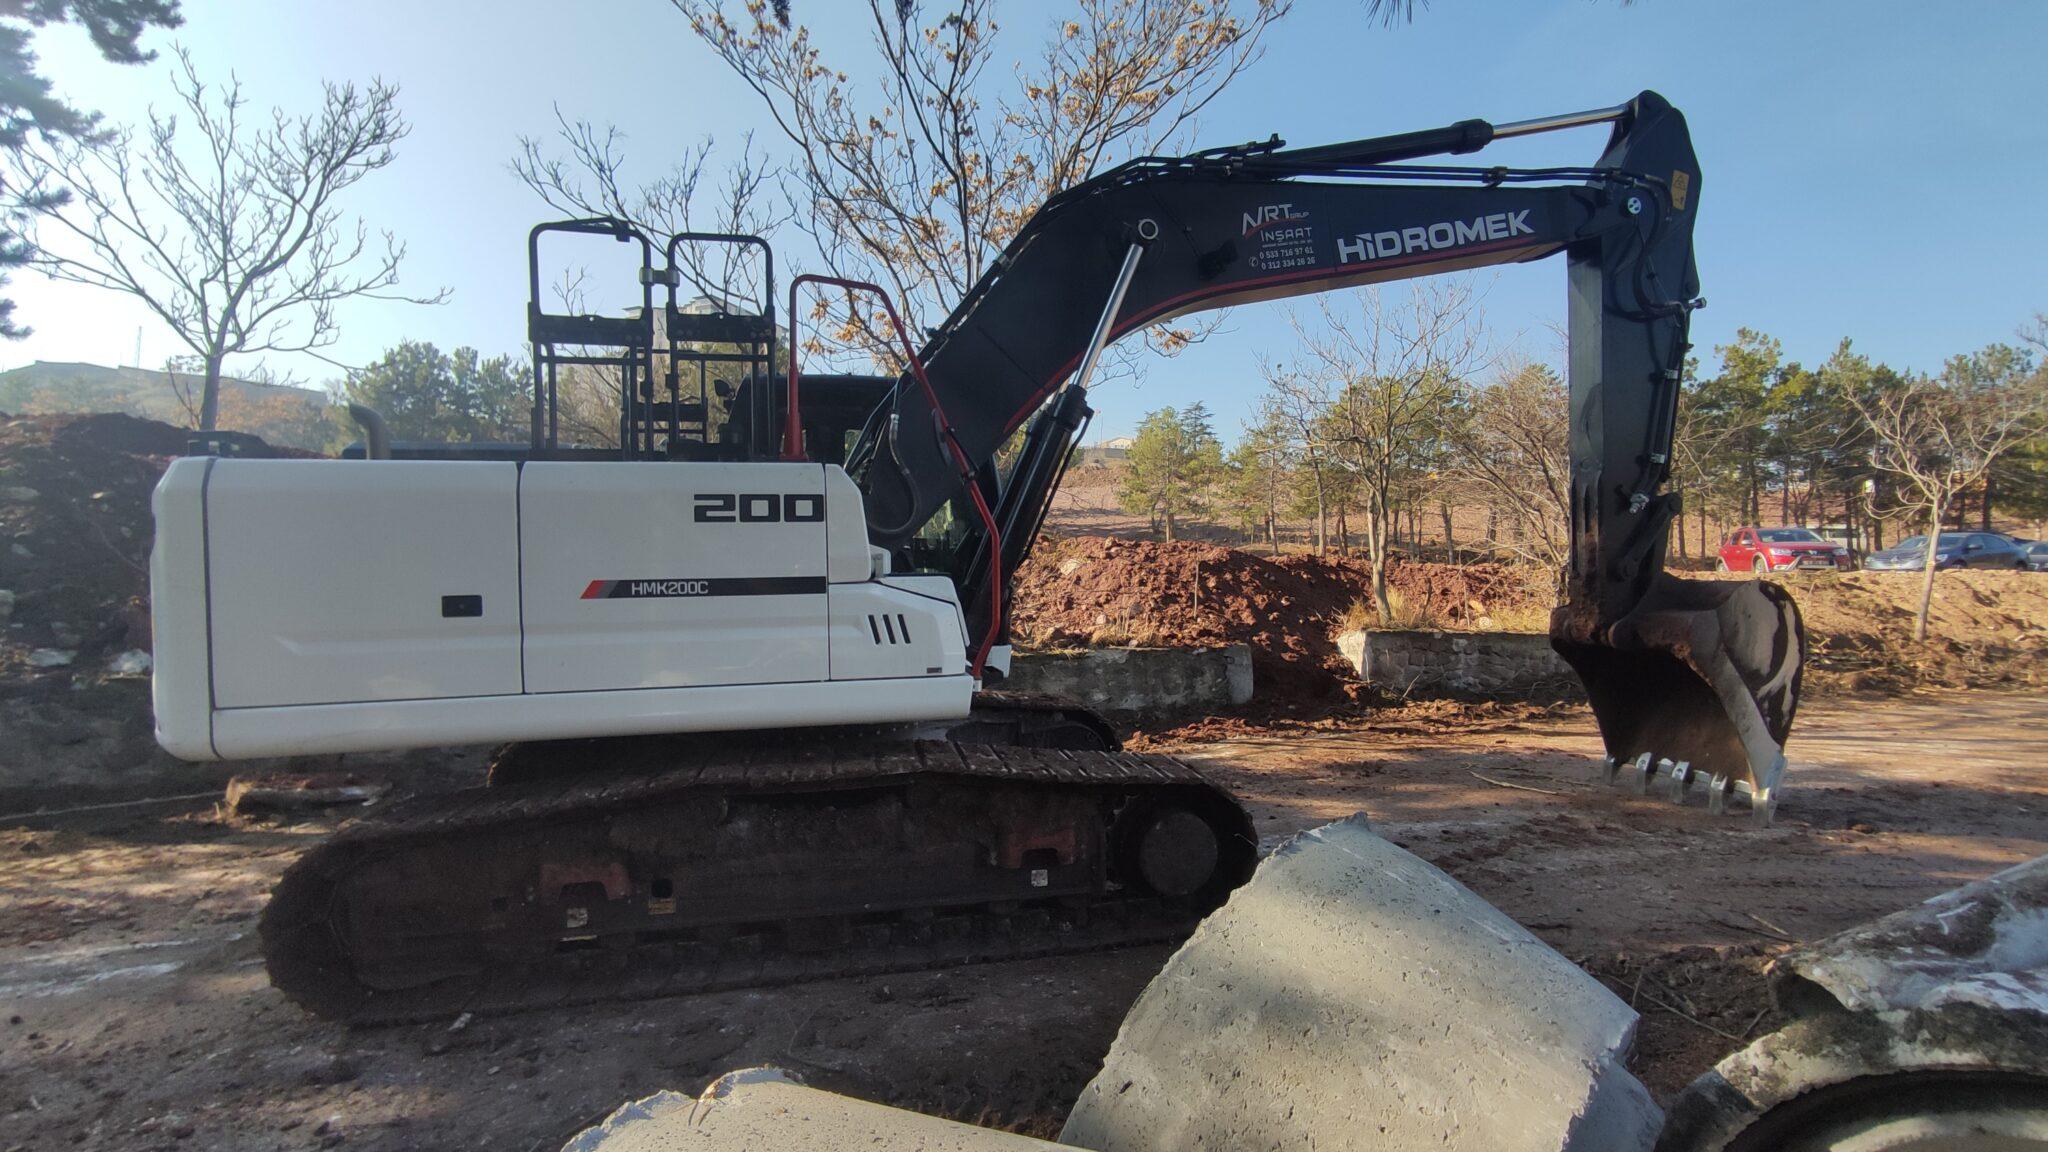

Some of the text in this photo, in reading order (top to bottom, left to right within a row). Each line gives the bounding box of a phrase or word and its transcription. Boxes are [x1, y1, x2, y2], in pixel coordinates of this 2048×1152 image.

[1242, 203, 1292, 235] NRT
[693, 494, 825, 523] 200
[631, 580, 709, 596] HMK200C
